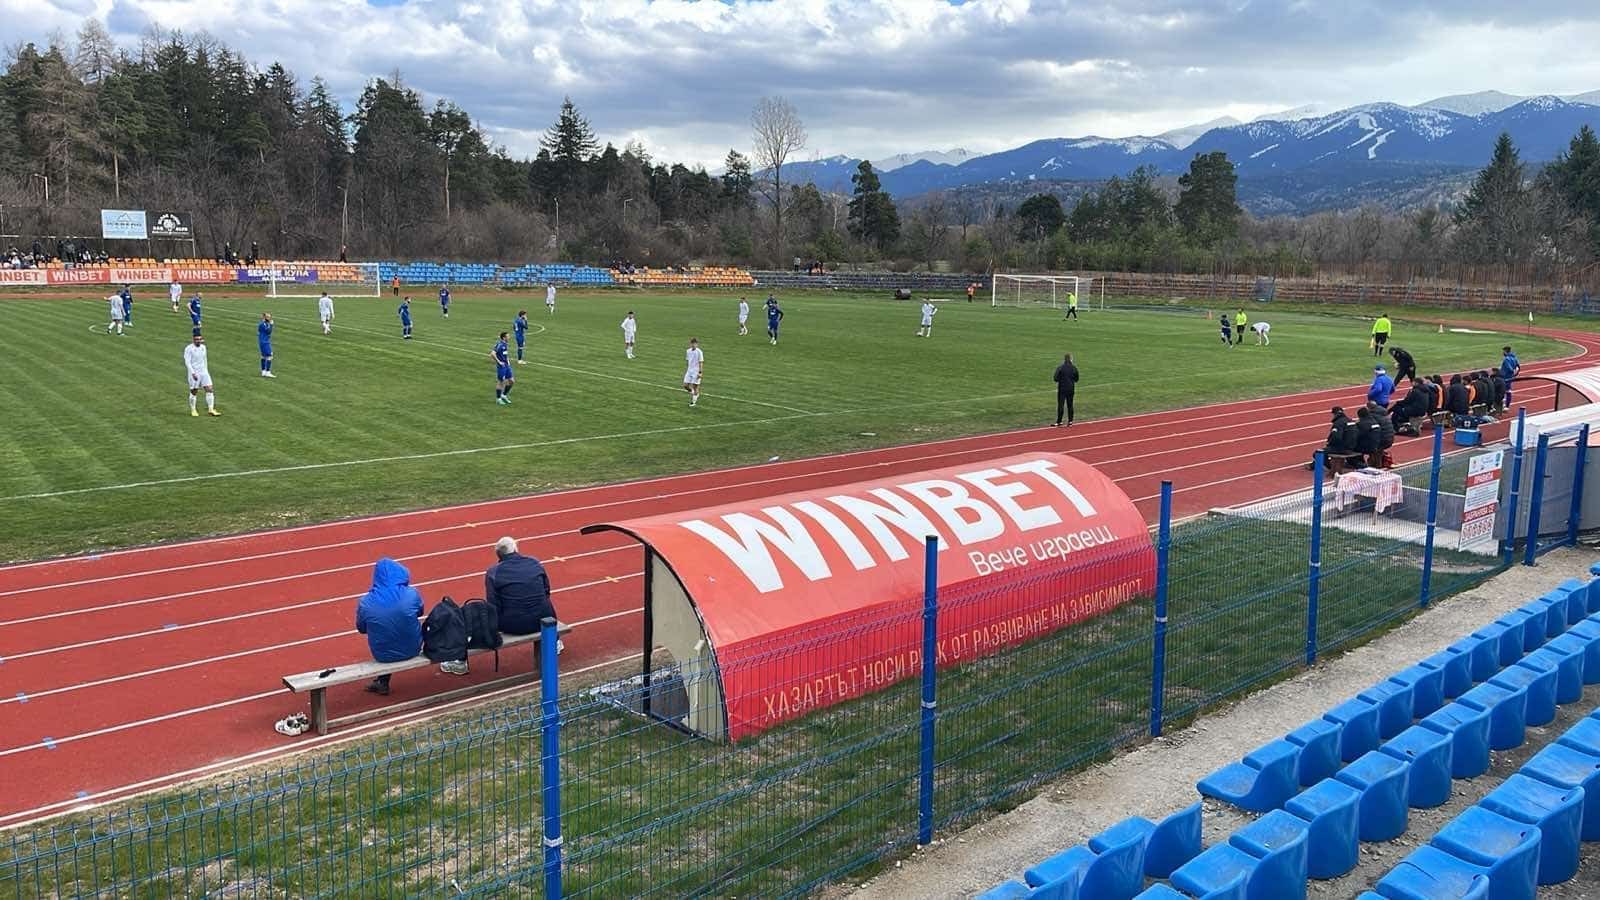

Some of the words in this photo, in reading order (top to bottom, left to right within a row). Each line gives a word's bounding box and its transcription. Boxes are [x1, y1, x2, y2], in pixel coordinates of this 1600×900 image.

[0, 271, 39, 281] INBET
[51, 270, 104, 282] WINBET
[117, 270, 166, 280] WINBET
[177, 269, 224, 280] WINBET
[678, 459, 1098, 593] WINBET
[968, 550, 1028, 577] Вече
[1030, 525, 1119, 561] играеш.
[764, 668, 857, 722] ХАЗАРТЪТ
[863, 654, 905, 688] НОСИ
[910, 640, 948, 673] РИК
[952, 632, 969, 659] ОТ
[973, 610, 1049, 651] РАЗВИВАНЕ
[1051, 606, 1069, 625] НА
[1071, 578, 1143, 619] ЗАВИСИМОСТ
